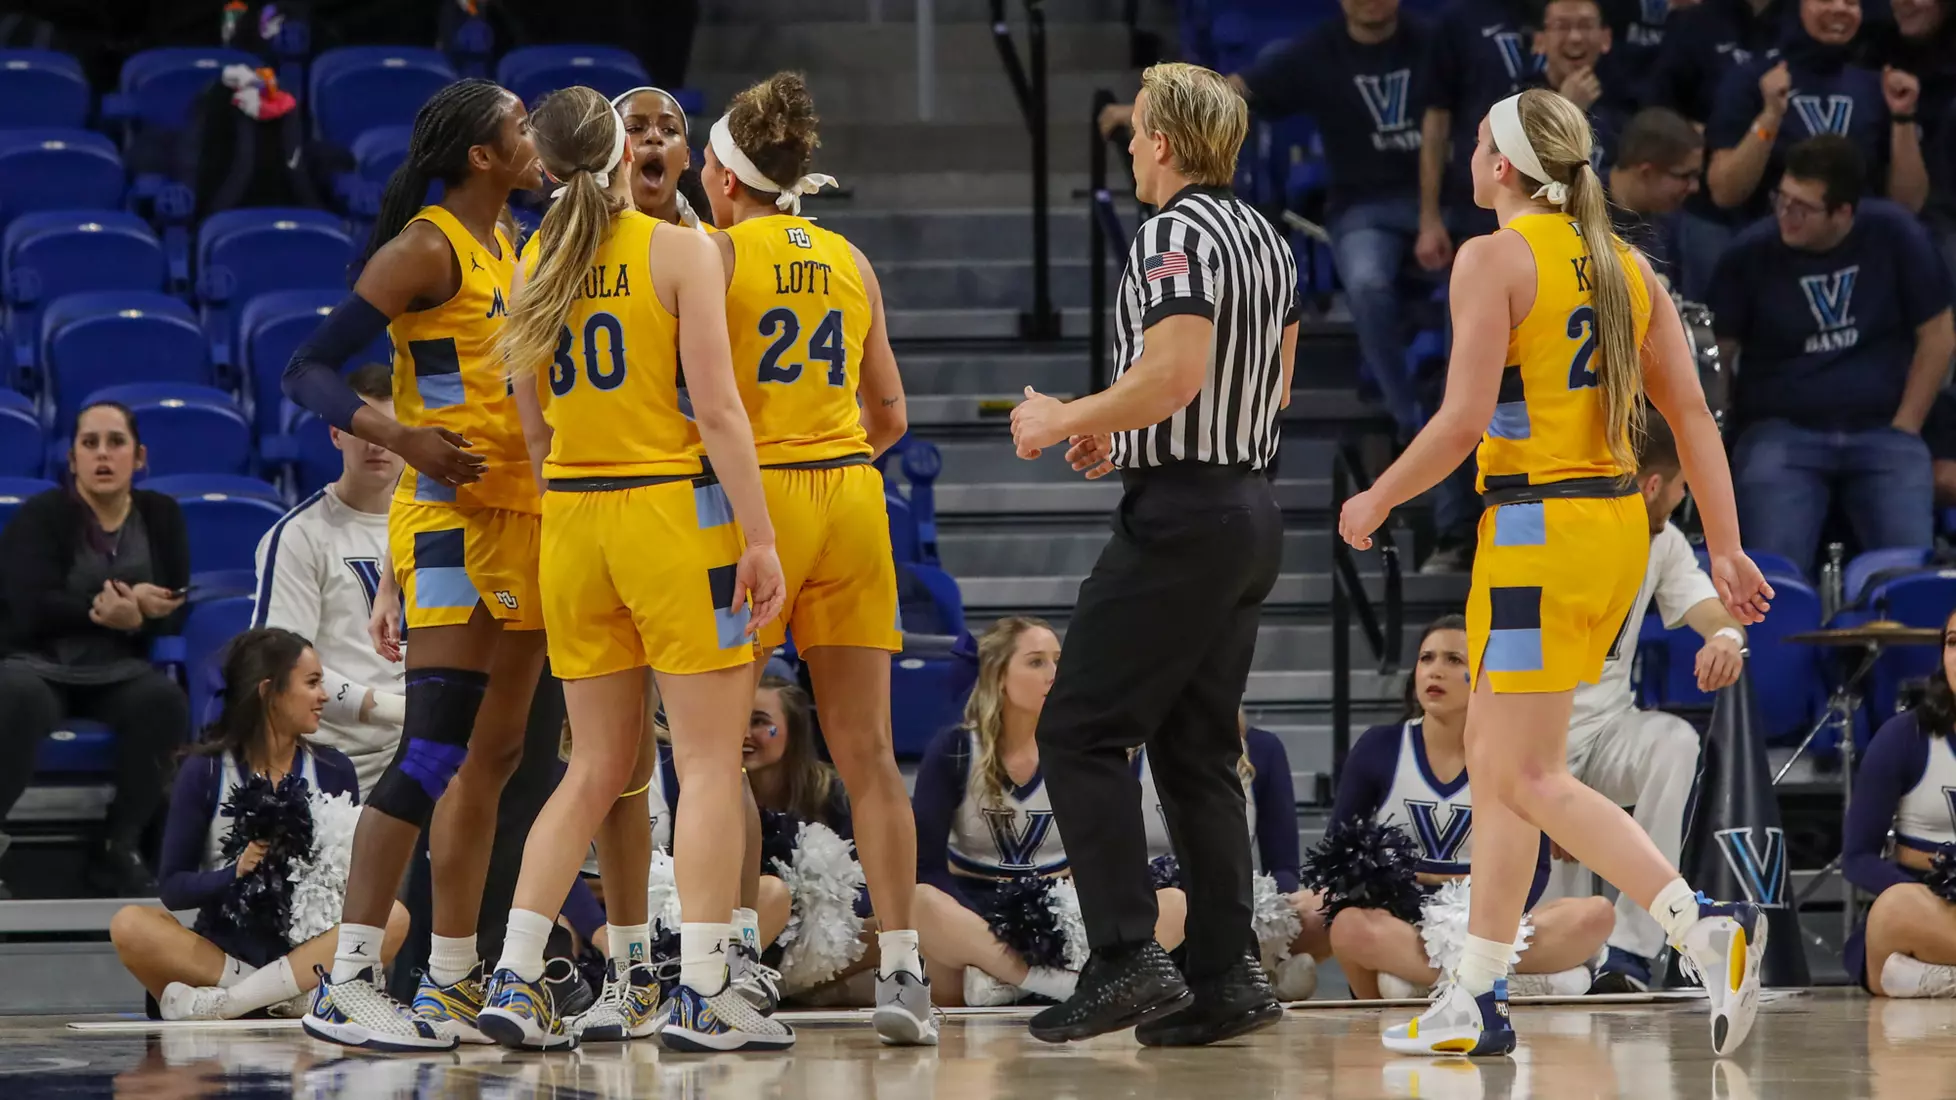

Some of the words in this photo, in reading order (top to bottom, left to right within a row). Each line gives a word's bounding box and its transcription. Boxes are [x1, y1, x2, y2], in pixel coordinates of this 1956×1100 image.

[1352, 68, 1411, 132] V
[1791, 94, 1853, 137] V
[784, 227, 812, 248] MU
[574, 264, 630, 299] OLA
[773, 260, 831, 295] LOTT
[1799, 264, 1859, 331] V
[549, 310, 628, 397] 30
[757, 306, 846, 387] 24
[1566, 305, 1601, 391] 2
[1804, 327, 1859, 353] BAND
[493, 590, 518, 609] MU
[982, 807, 1055, 869] V
[1403, 798, 1473, 863] V
[1713, 826, 1787, 908] V
